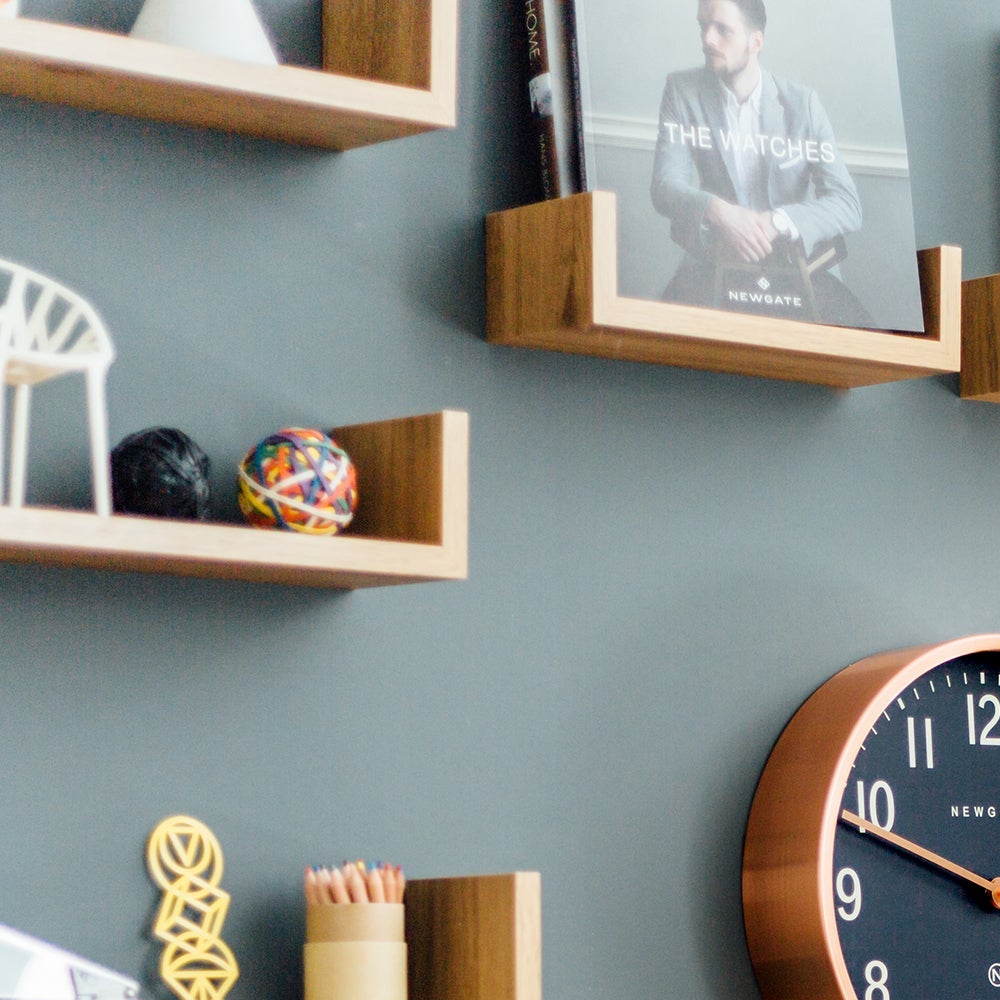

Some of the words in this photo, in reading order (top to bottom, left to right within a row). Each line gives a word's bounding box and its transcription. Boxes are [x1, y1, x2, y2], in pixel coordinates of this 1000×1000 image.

[663, 122, 712, 148] THE
[720, 129, 835, 163] WATCHES
[728, 291, 802, 306] NEWGATE
[907, 717, 933, 768] 11
[858, 780, 895, 834] 10
[836, 868, 861, 921] 9
